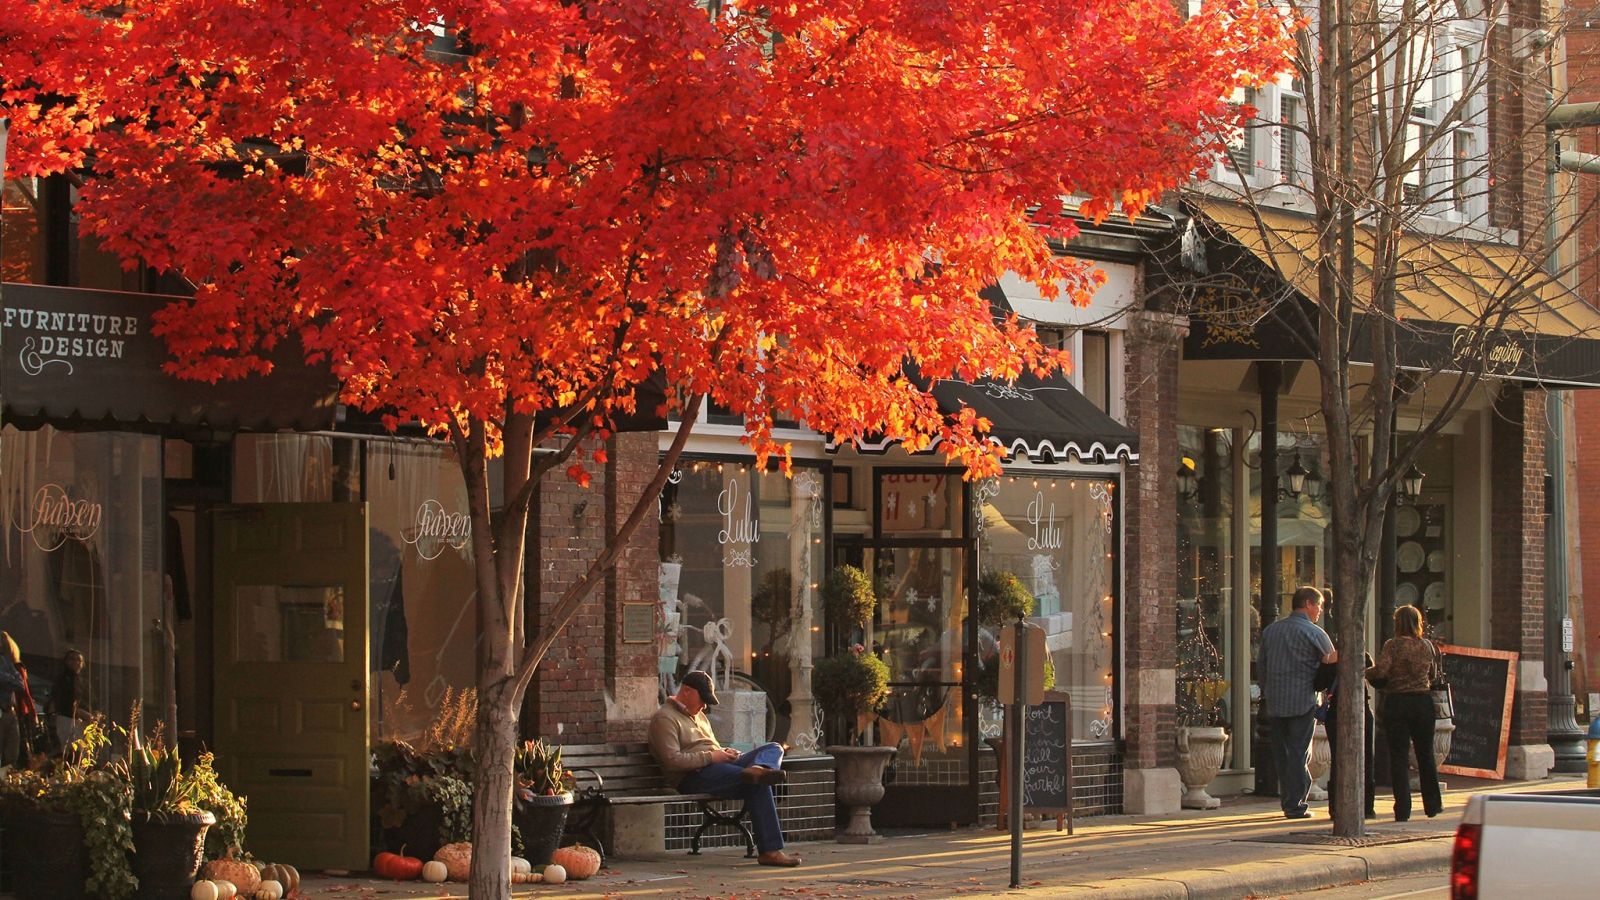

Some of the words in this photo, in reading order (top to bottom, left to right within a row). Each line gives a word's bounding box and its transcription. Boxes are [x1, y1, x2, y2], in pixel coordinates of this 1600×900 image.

[3, 307, 138, 335] FURNITURE
[19, 336, 74, 376] &
[39, 336, 125, 359] DESIGN
[717, 478, 761, 544] Lulu
[1027, 491, 1061, 550] Lulu
[1023, 775, 1066, 805] parkle!
